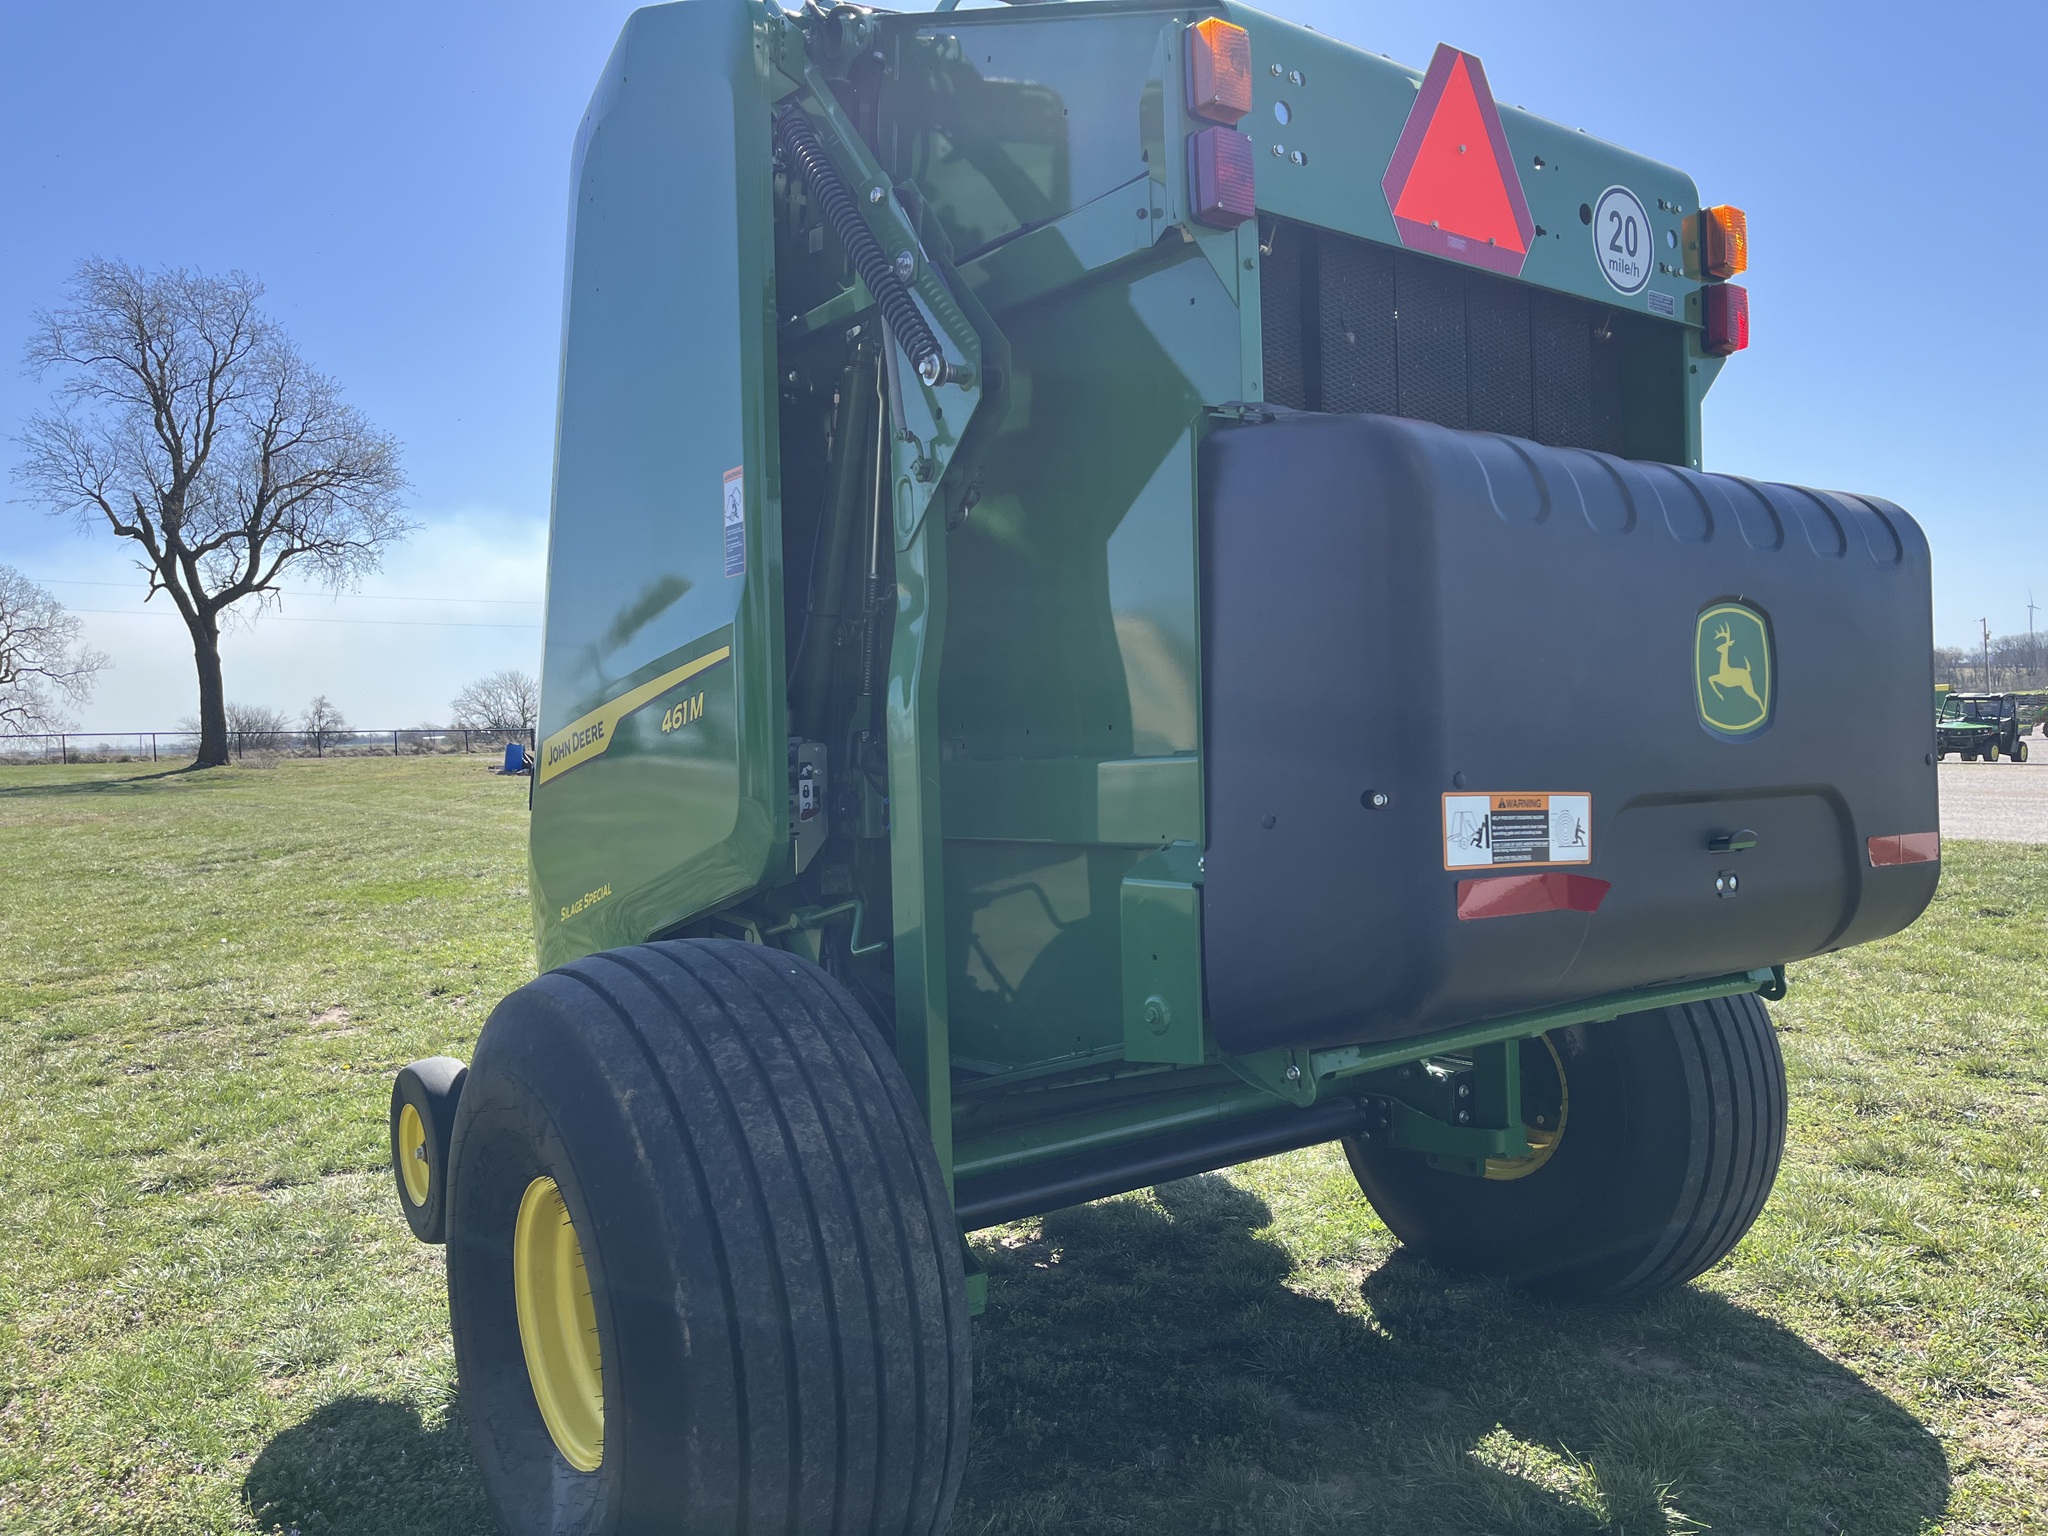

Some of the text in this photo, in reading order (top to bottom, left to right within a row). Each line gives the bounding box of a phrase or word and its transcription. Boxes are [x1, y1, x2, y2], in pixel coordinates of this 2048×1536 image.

[1609, 210, 1638, 258] 20
[1609, 258, 1640, 278] mile/h
[661, 691, 704, 734] 461M
[548, 720, 605, 766] JOHN DEERE
[1506, 799, 1541, 808] WARNING
[560, 882, 612, 922] SILAGE SPECIAL
